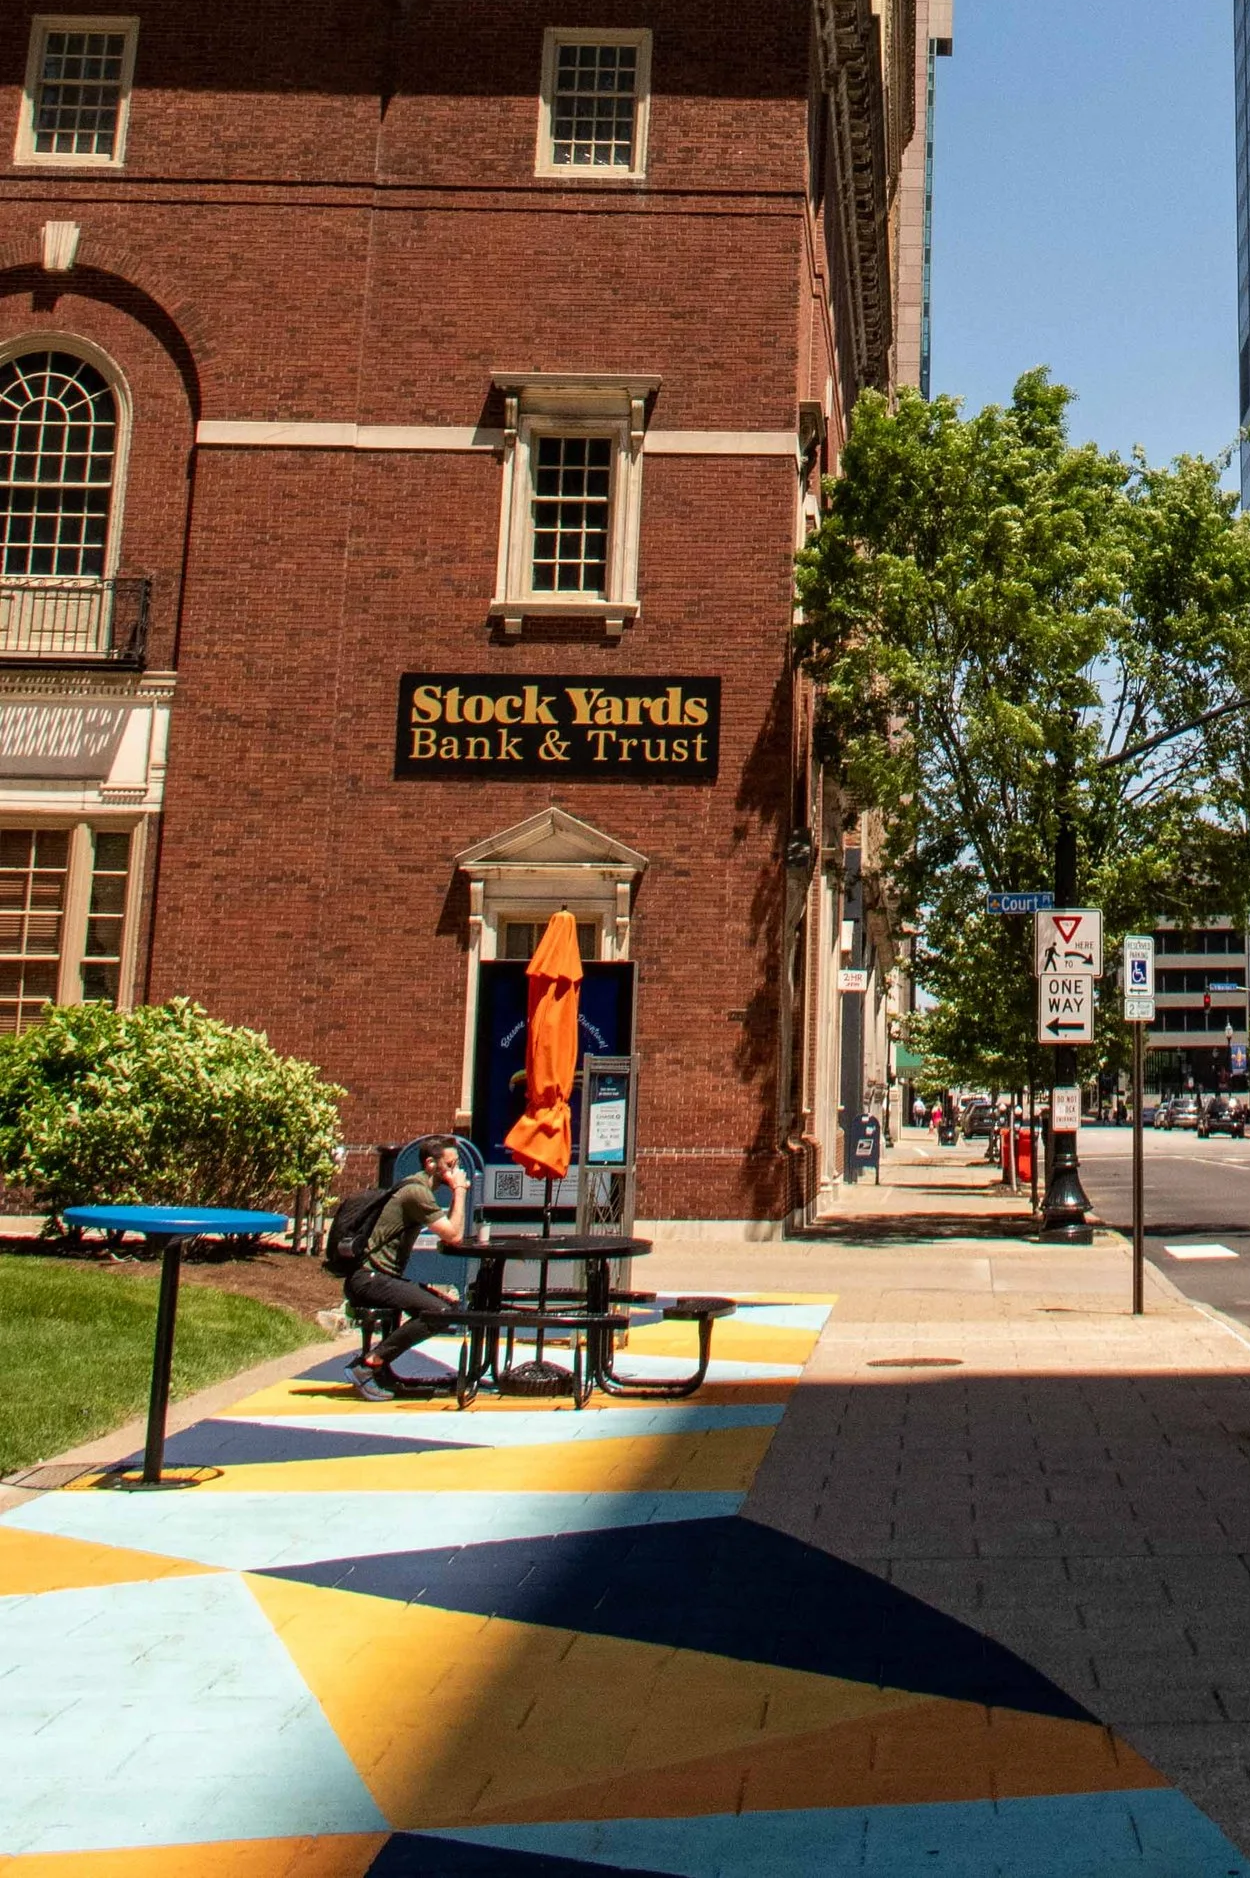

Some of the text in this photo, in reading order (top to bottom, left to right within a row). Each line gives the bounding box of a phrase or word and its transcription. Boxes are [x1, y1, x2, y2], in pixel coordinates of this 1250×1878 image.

[411, 685, 709, 726] Stock Yards
[408, 727, 709, 762] Bank & Trust
[1001, 896, 1038, 911] Court
[1075, 942, 1095, 950] HERE
[1064, 960, 1074, 969] TO
[1049, 979, 1084, 995] ONE
[1048, 998, 1084, 1013] WAY
